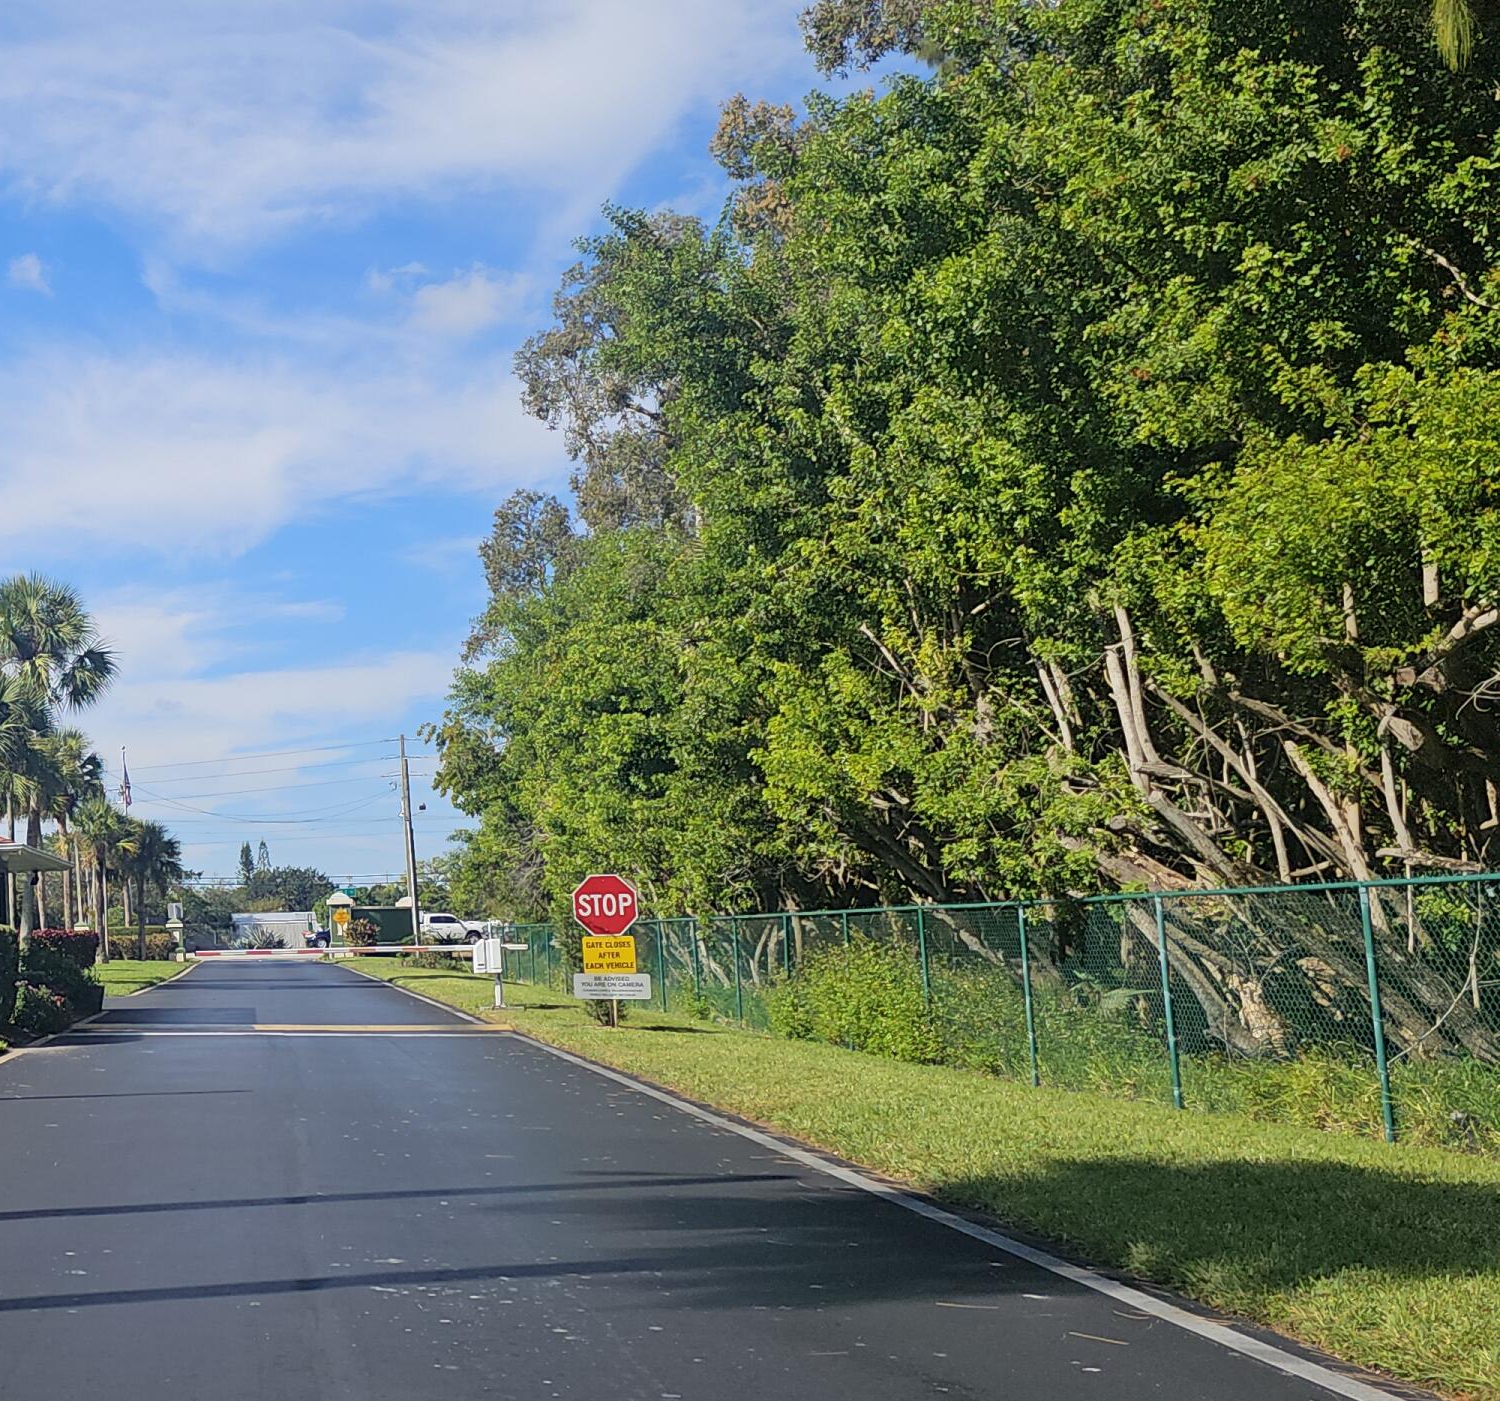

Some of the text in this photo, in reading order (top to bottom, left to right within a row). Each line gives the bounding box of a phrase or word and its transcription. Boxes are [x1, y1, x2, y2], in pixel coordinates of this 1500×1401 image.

[578, 893, 632, 916] STOP
[586, 941, 603, 949] GATE
[598, 951, 620, 959] AFTER
[585, 961, 634, 970] EACH VEHICLE
